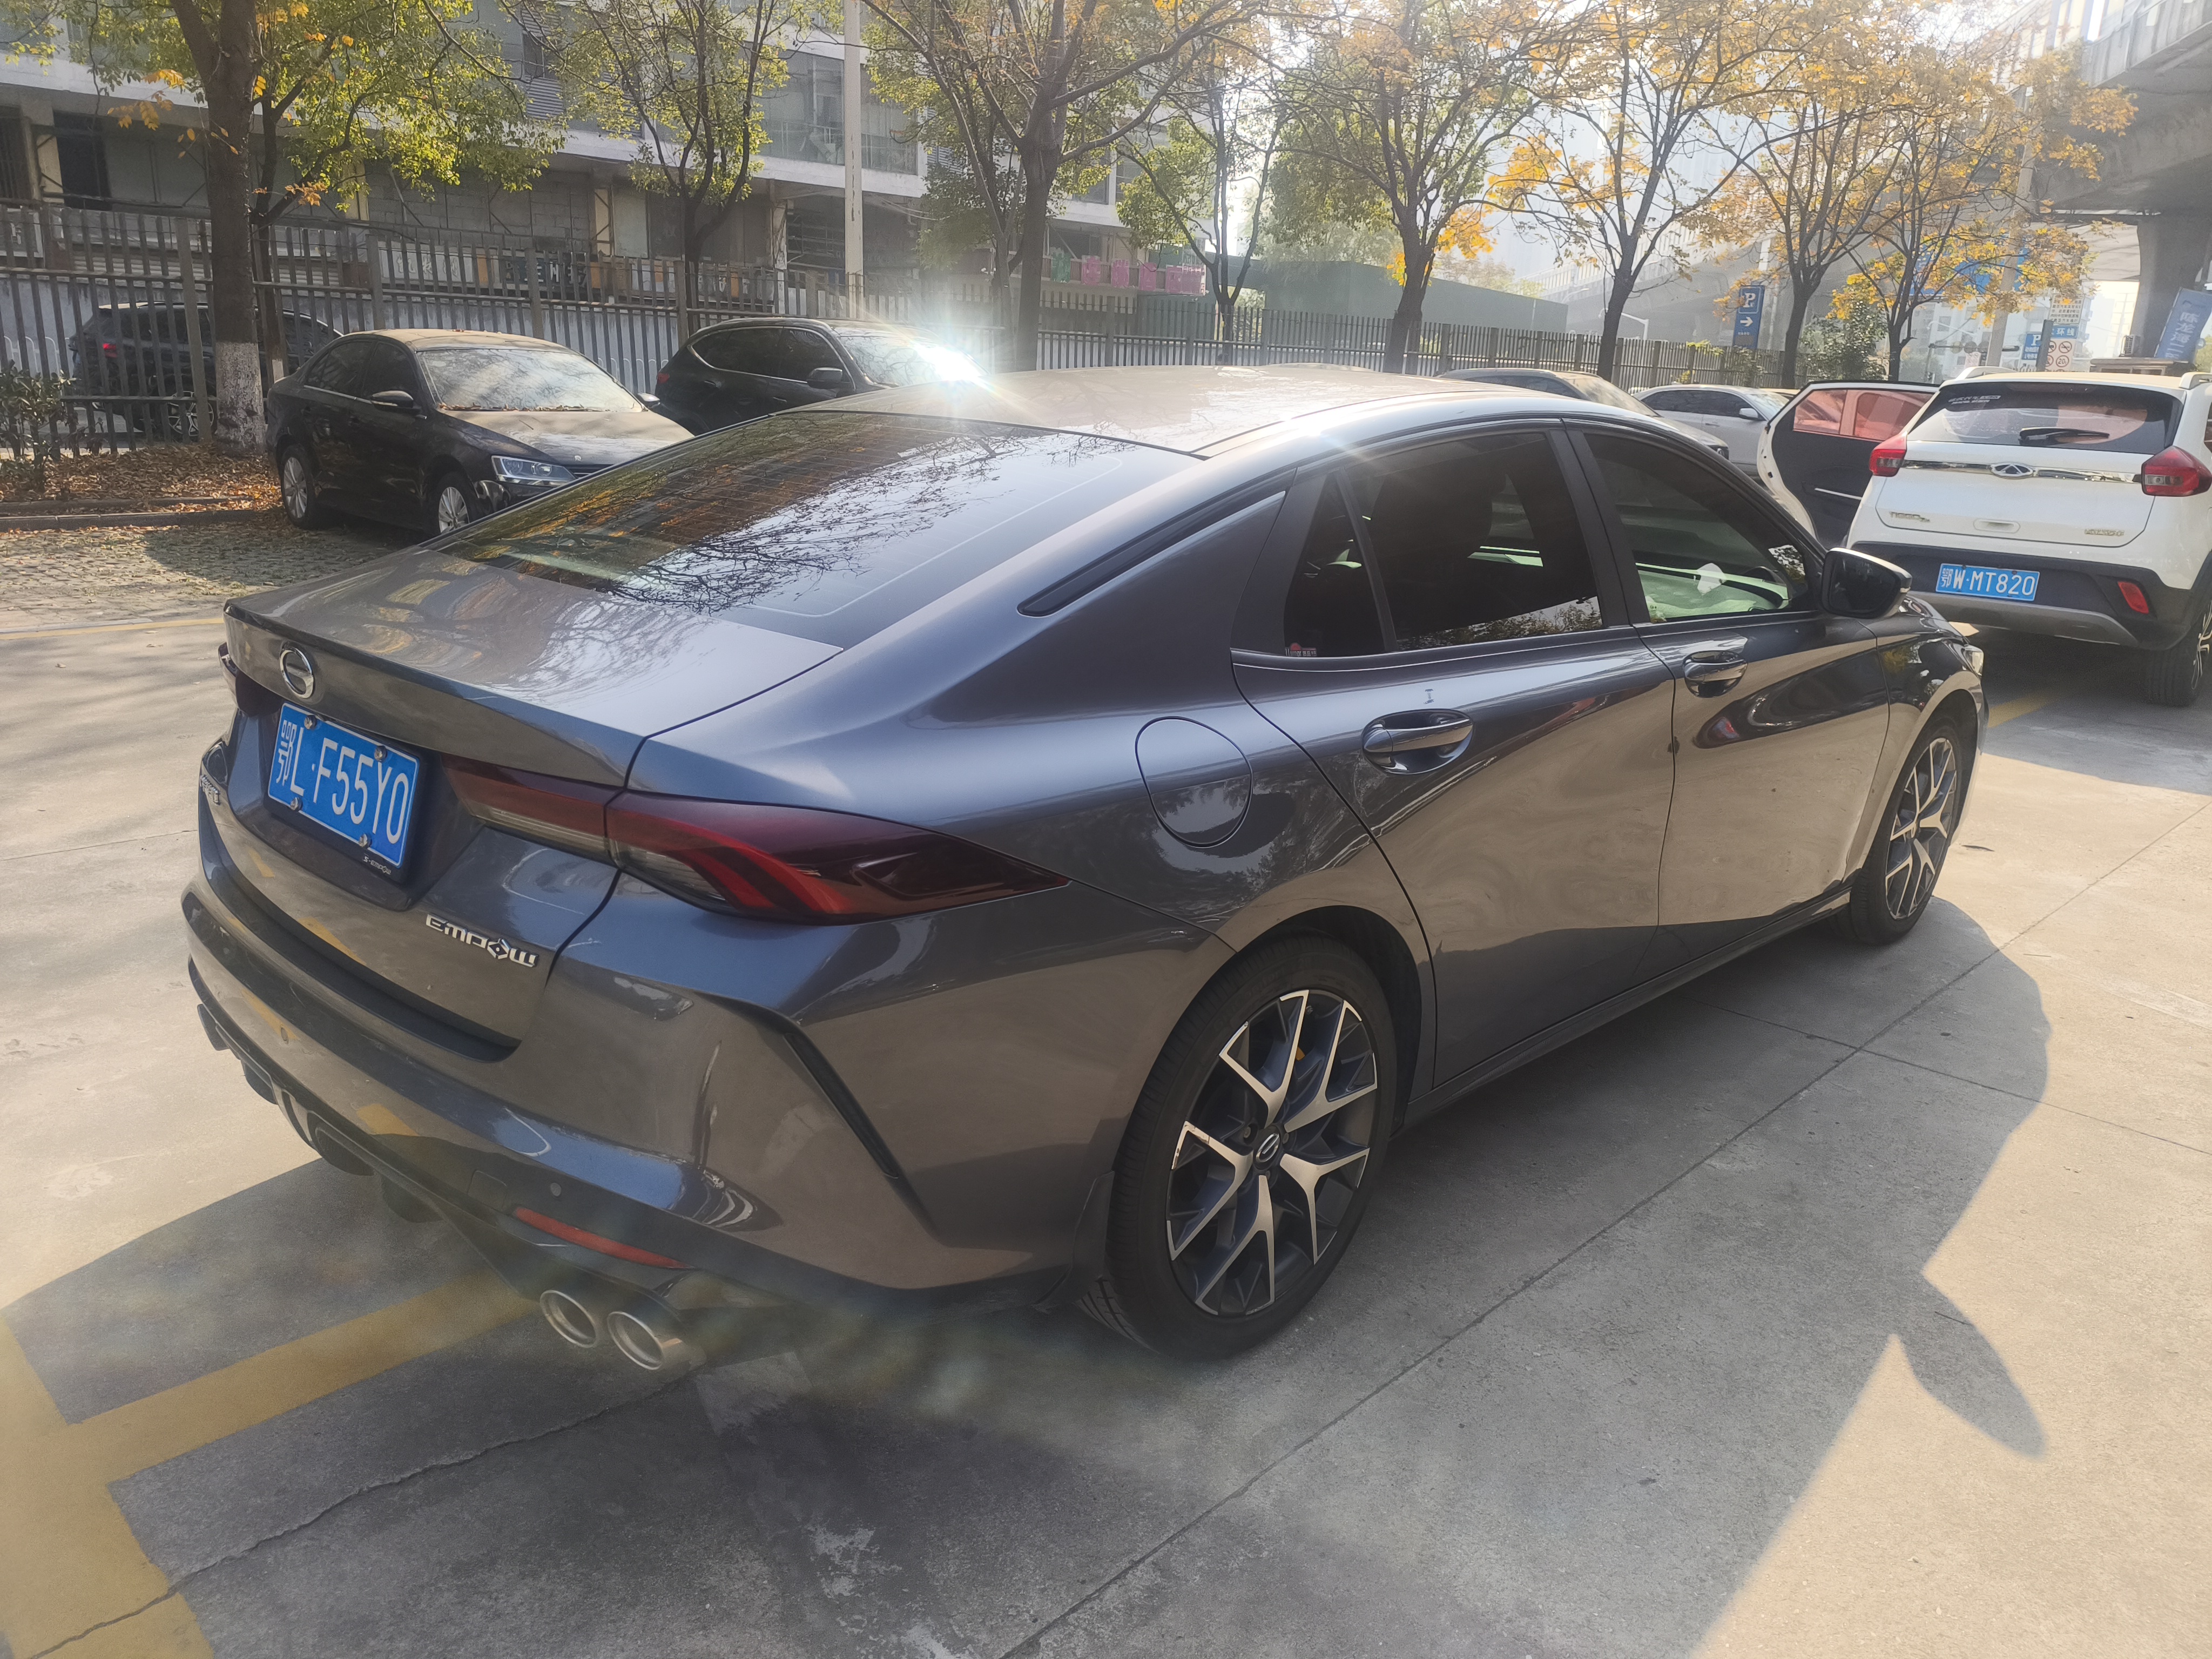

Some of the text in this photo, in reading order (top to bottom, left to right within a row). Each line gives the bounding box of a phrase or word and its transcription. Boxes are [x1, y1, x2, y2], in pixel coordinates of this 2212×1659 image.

[1743, 293, 1756, 308] P
[2051, 327, 2075, 336] 环线
[2031, 334, 2041, 346] P
